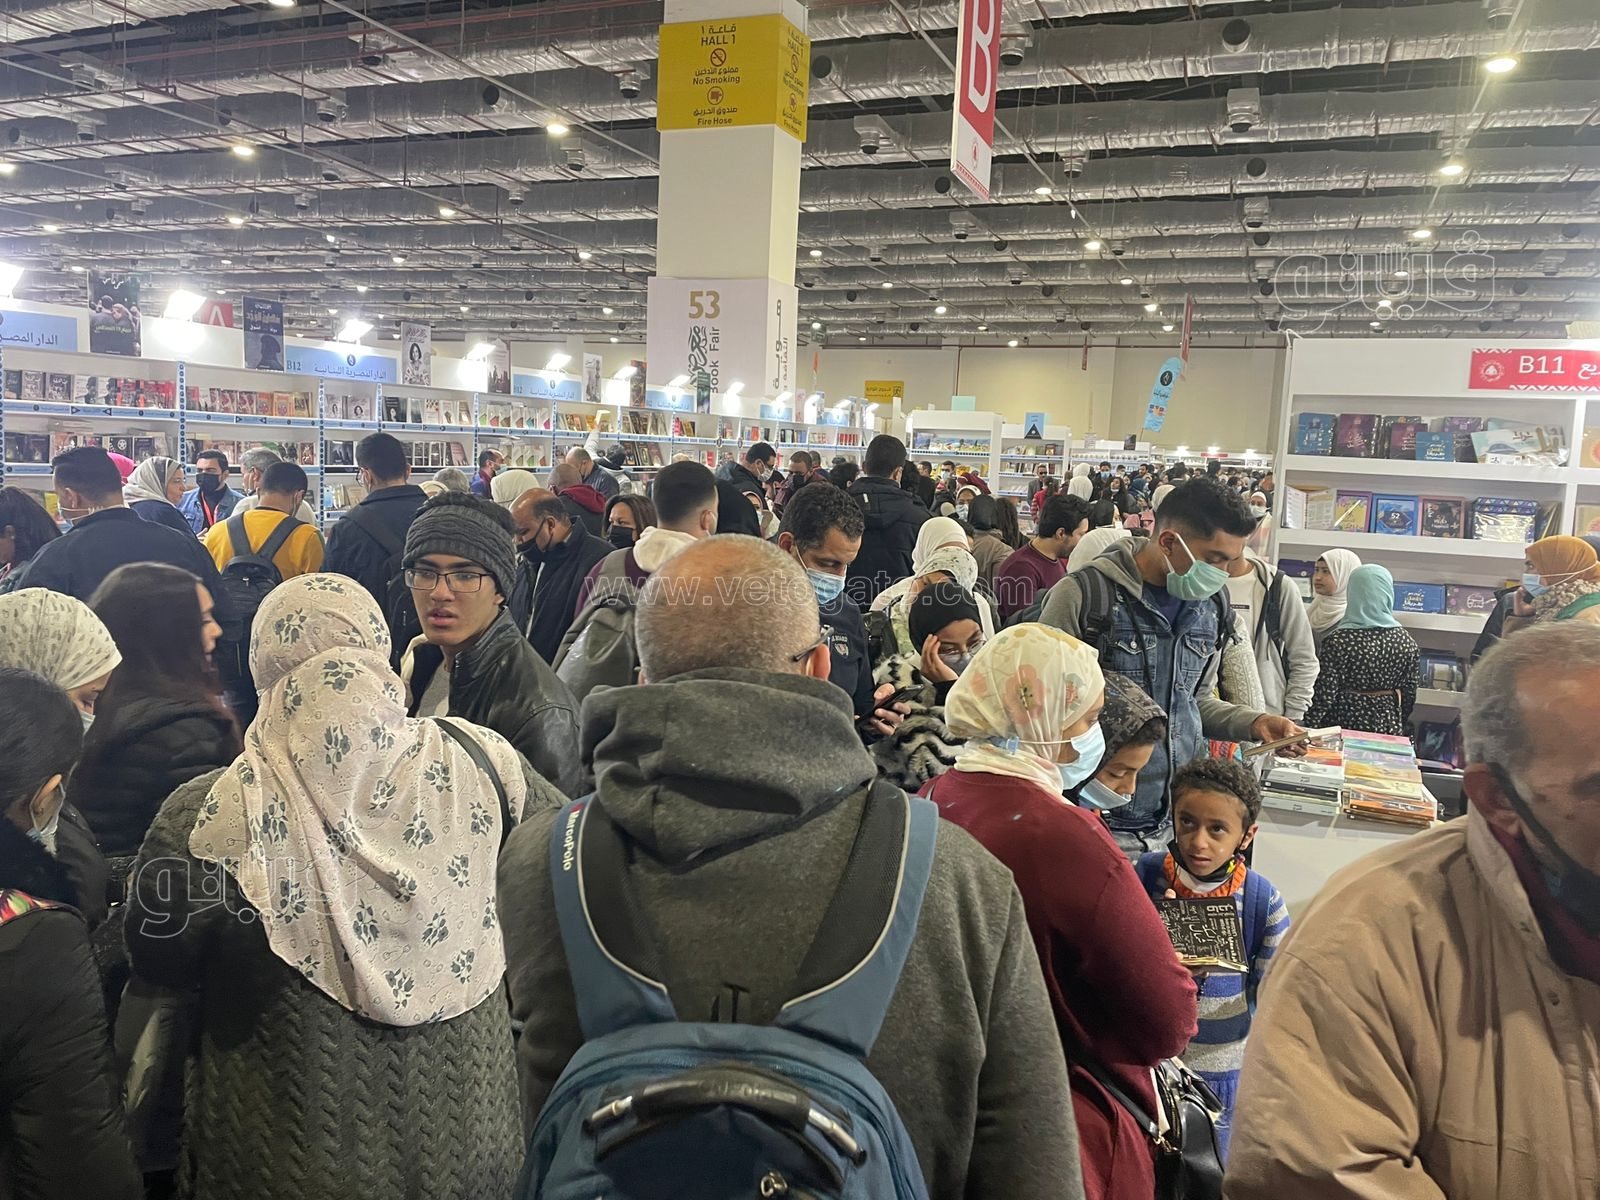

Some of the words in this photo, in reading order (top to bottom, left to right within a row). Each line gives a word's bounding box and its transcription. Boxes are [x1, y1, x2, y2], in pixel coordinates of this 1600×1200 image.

[709, 24, 736, 34] قاعة
[701, 34, 728, 47] HALL
[731, 33, 736, 45] 1
[694, 67, 717, 77] التدخين
[718, 67, 739, 76] ممنوع
[692, 77, 704, 86] No
[705, 75, 741, 85] Smoking
[693, 107, 716, 117] الحريق
[716, 107, 738, 116] صندوق
[697, 118, 712, 126] Fire
[713, 116, 733, 125] Hose
[688, 290, 721, 320] 53
[35, 332, 58, 346] الدار
[709, 326, 720, 352] Fair
[286, 360, 301, 371] B12
[1519, 355, 1565, 375] B11
